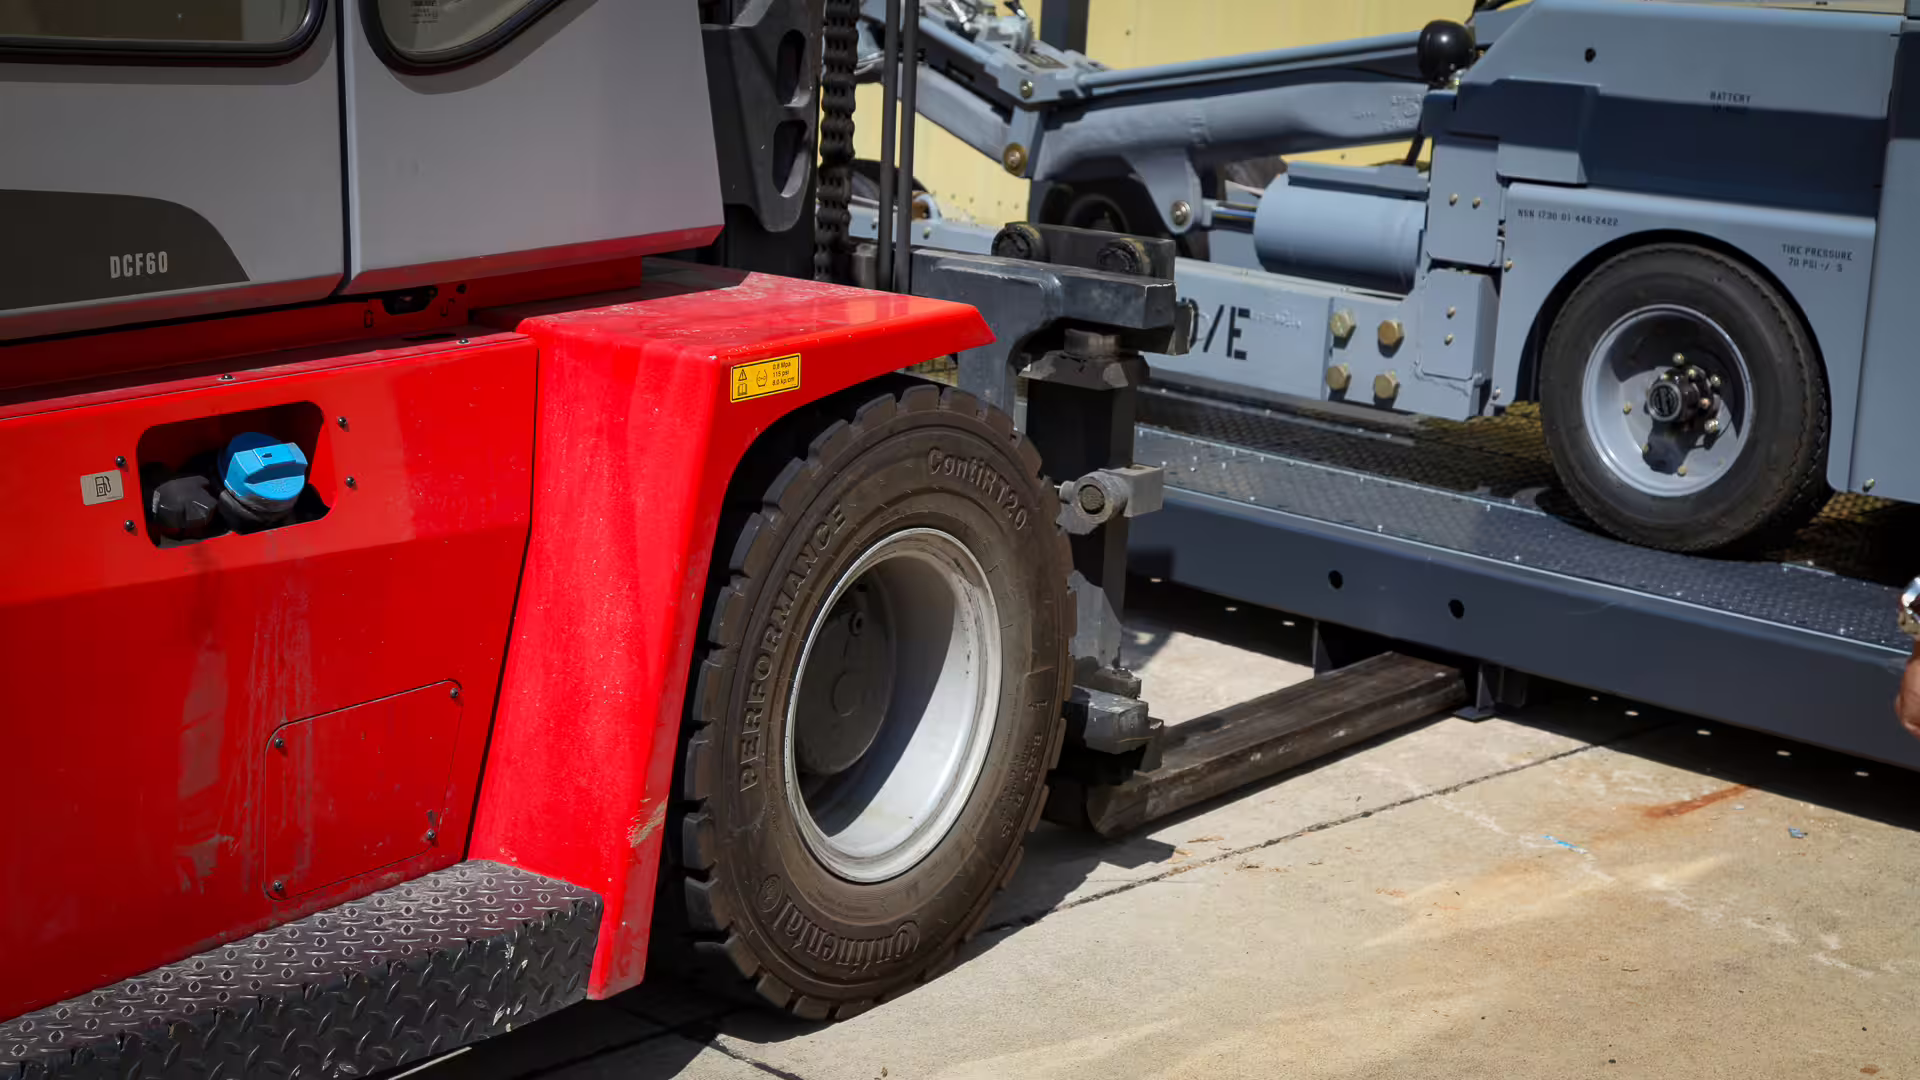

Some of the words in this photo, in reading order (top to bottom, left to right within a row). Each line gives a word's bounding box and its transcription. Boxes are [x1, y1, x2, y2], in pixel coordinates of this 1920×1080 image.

[1710, 90, 1751, 104] BATTERY
[110, 251, 168, 279] DCF60
[1782, 243, 1802, 255] TIRE
[1805, 247, 1853, 261] PRESSURE
[928, 447, 1027, 531] ContiRT20
[740, 502, 847, 792] PERFORMANCE
[773, 893, 920, 974] Continental
